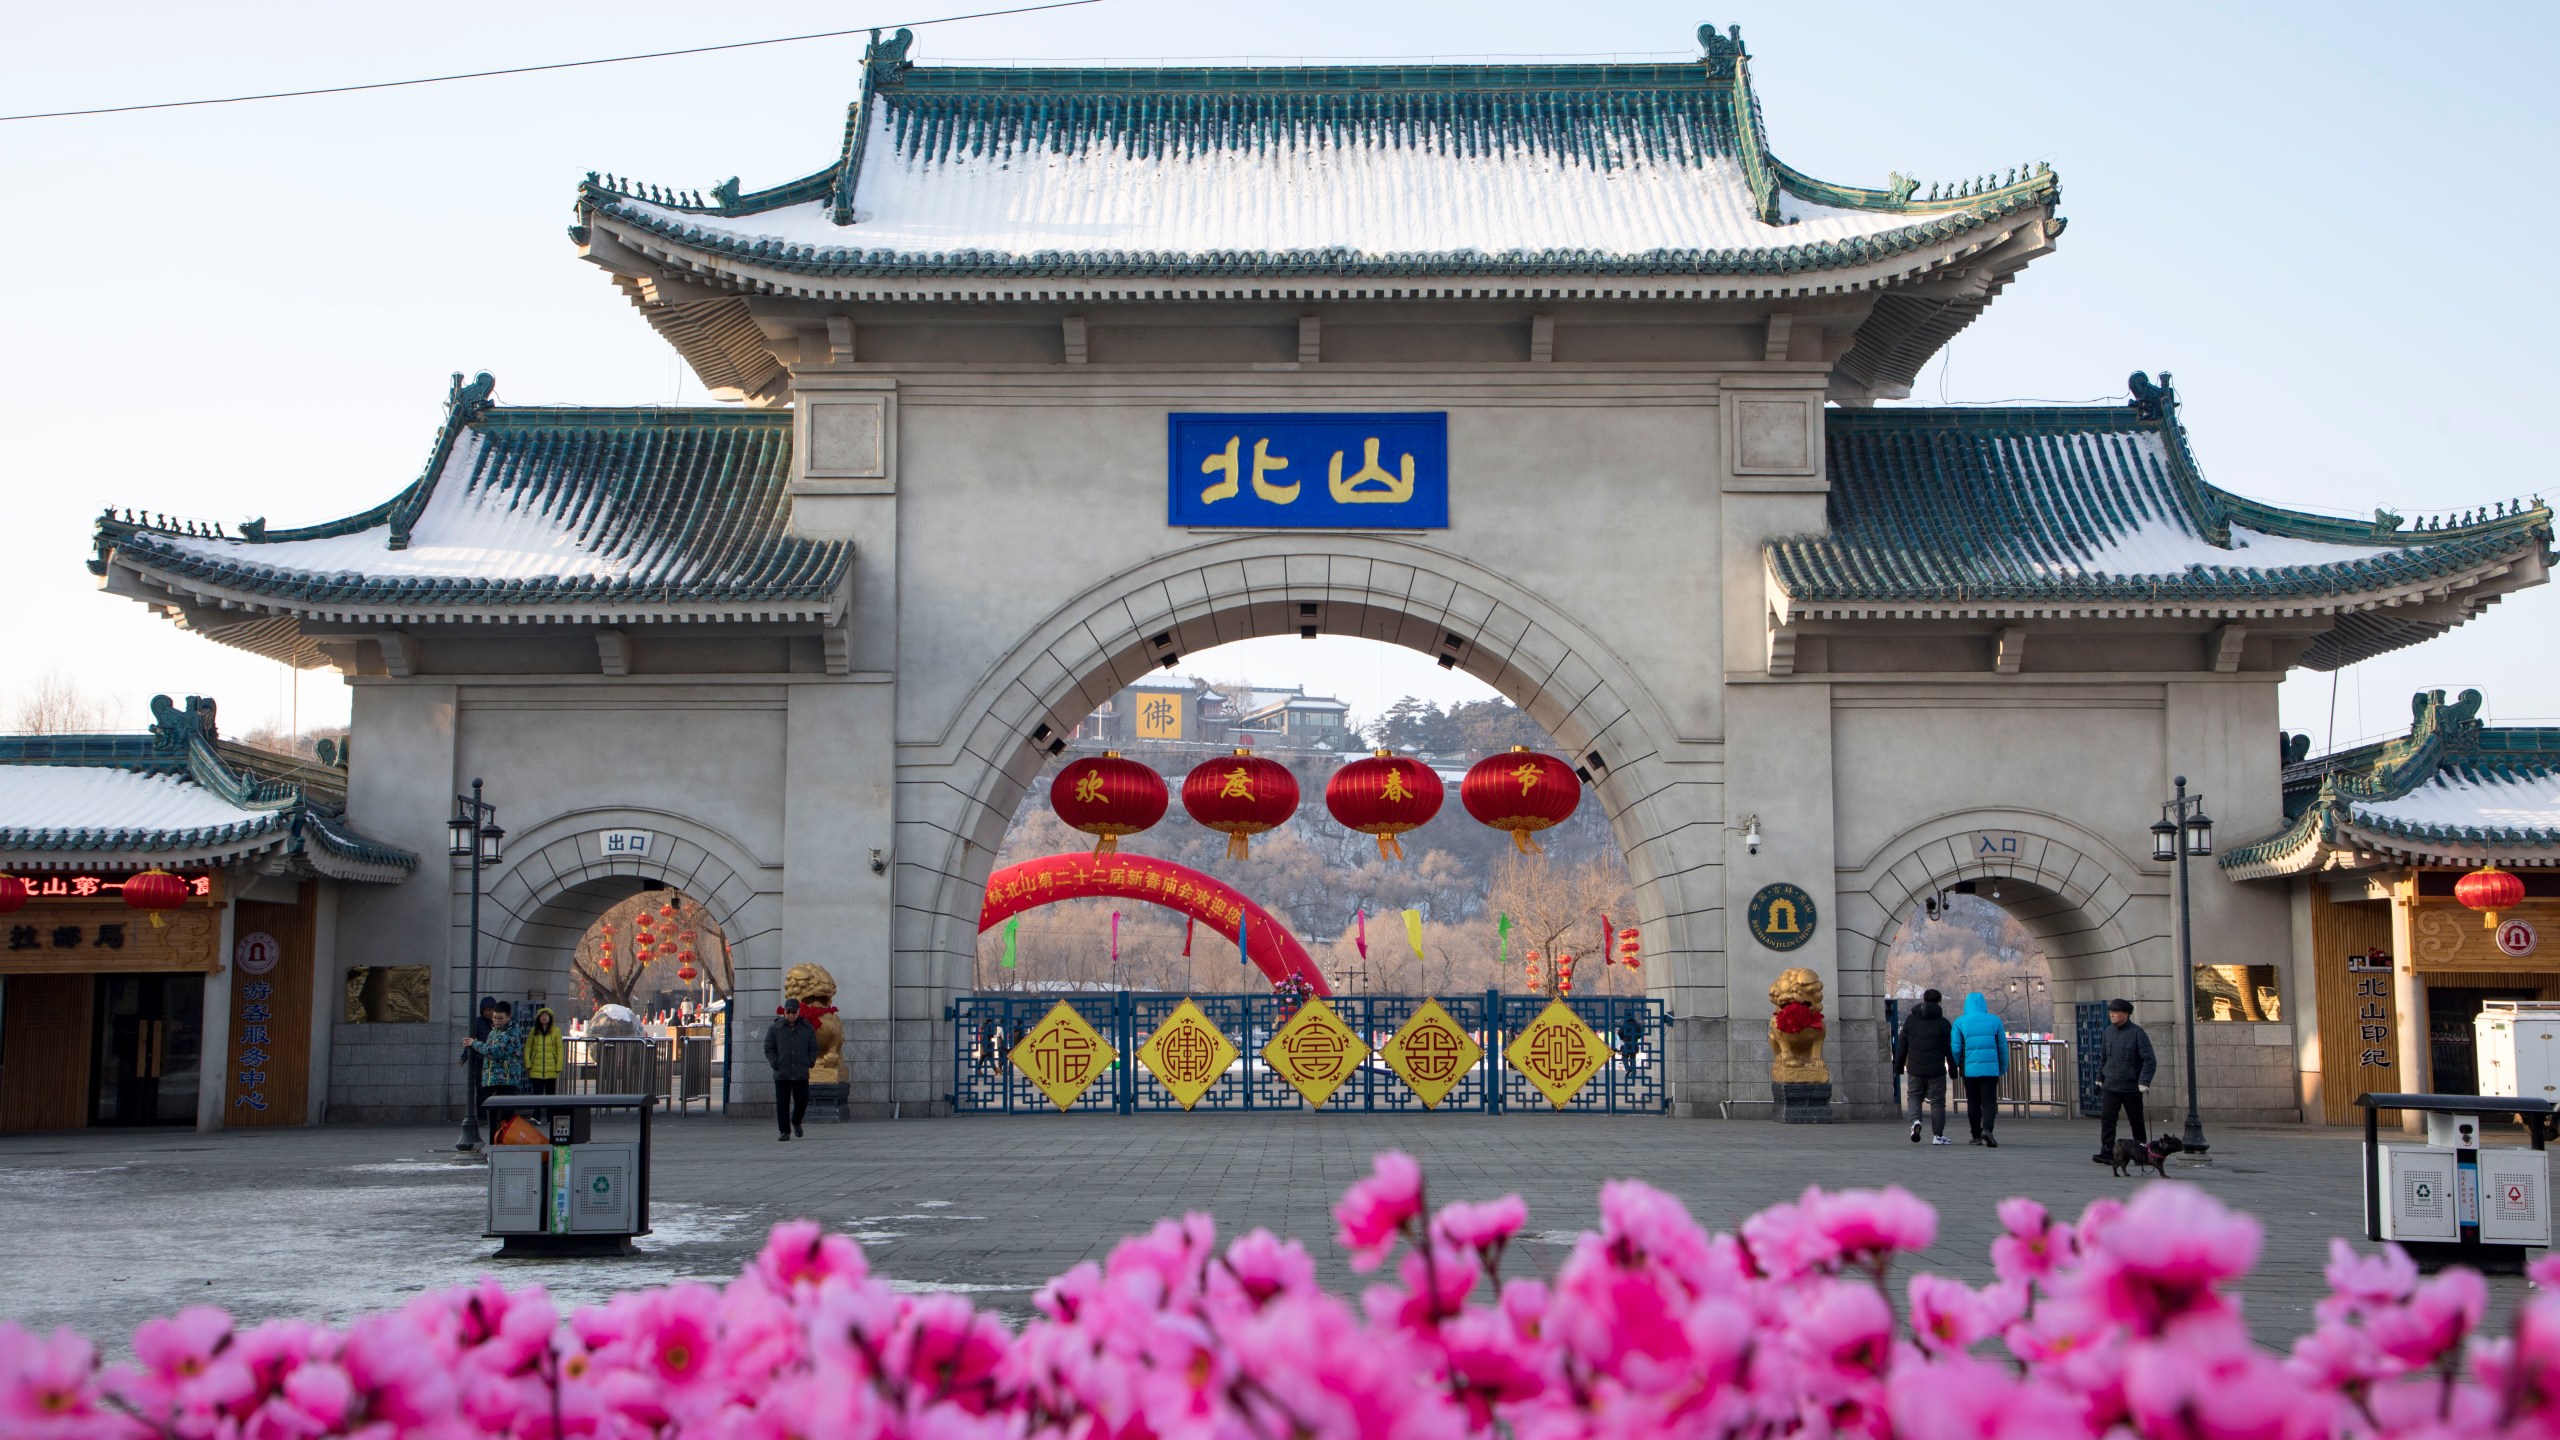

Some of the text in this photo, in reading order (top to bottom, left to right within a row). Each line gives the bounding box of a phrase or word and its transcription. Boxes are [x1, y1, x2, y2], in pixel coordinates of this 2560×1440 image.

[1200, 434, 1416, 505] 北山
[1142, 697, 1176, 734] 佛
[1075, 761, 1545, 805] 欢 度 春 节
[608, 834, 645, 853] 出口
[1980, 835, 2018, 854] 入口
[982, 868, 1241, 926] 林北山第二十二届新春庙会欢迎您
[1752, 919, 1775, 947] BEISHAN
[1796, 922, 1813, 944] CHINA
[2357, 977, 2392, 1068] 北山印纪
[235, 980, 273, 1111] 游客服务中心
